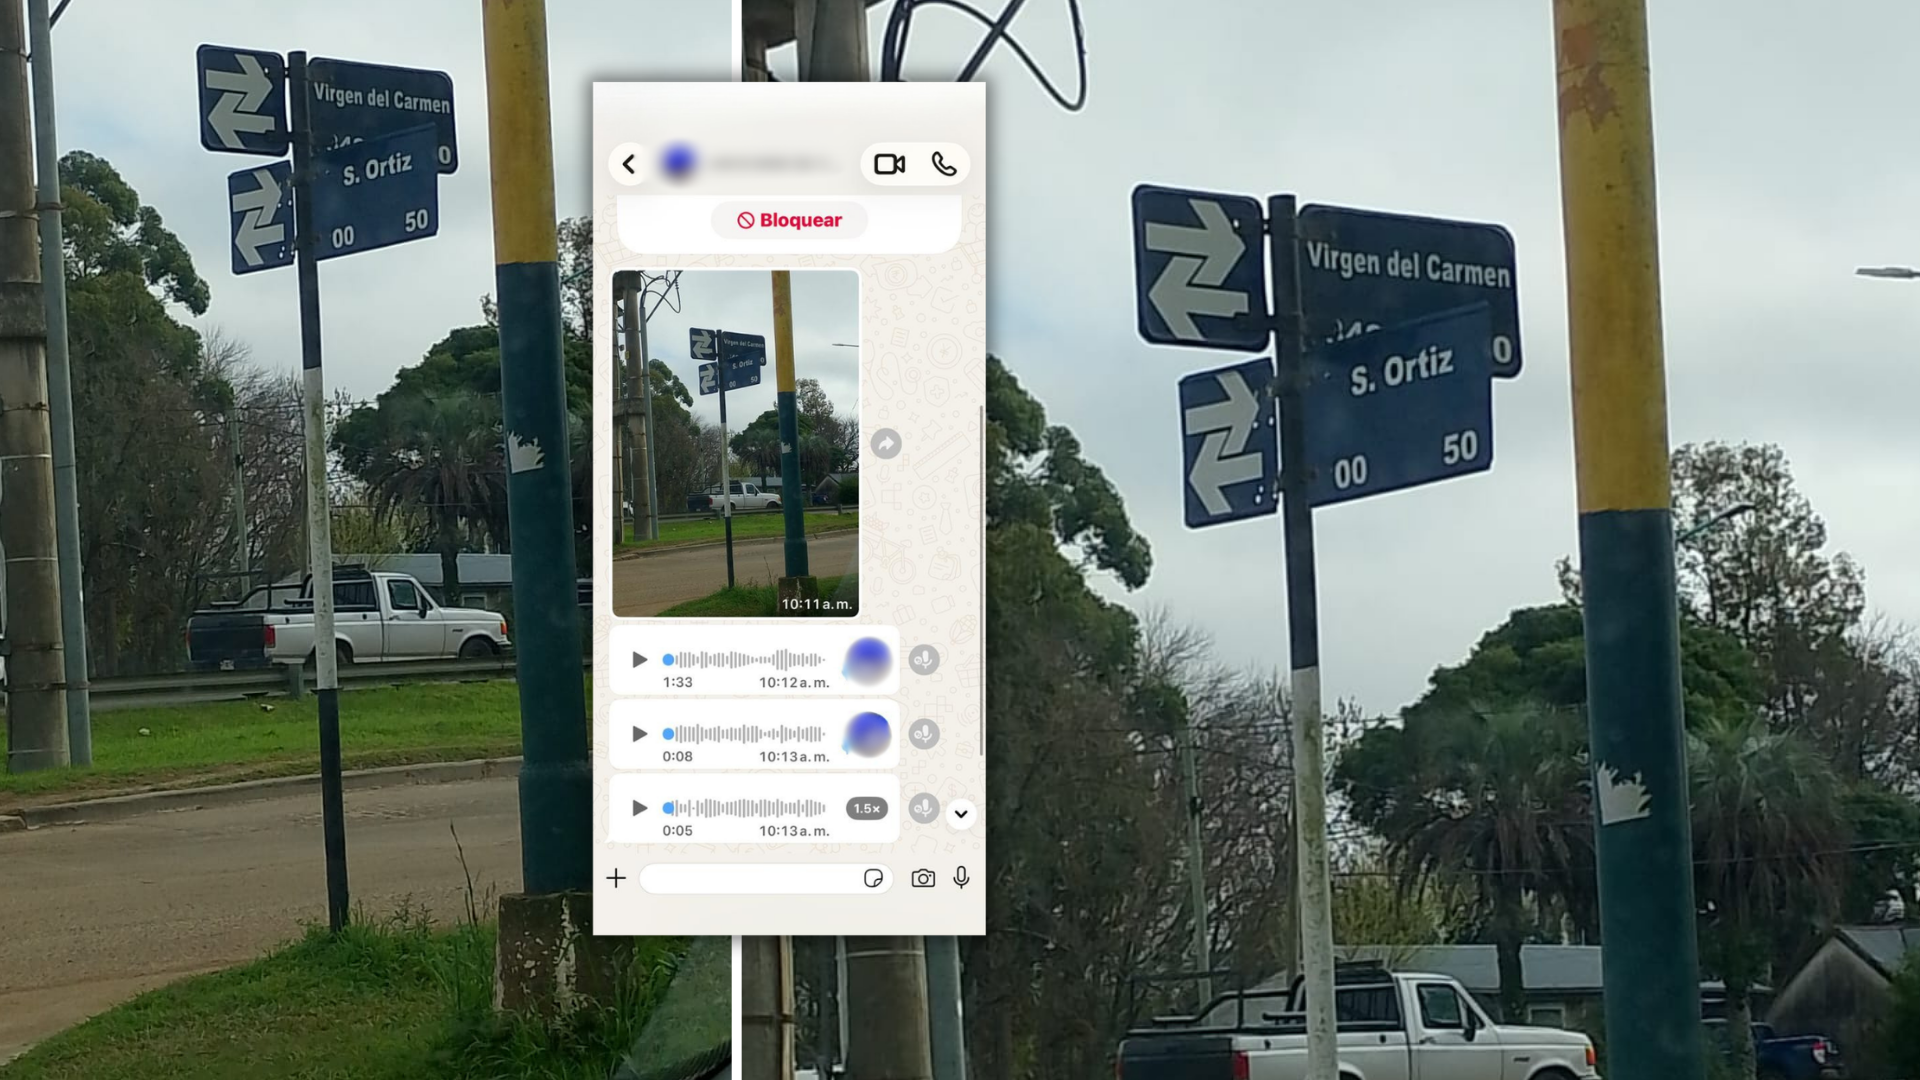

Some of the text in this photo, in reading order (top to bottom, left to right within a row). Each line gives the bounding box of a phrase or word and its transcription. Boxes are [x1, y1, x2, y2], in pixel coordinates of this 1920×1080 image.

[314, 82, 451, 114] Virgen del Carmen
[343, 153, 413, 186] S. Ortiz
[405, 208, 429, 232] 50
[760, 212, 843, 230] Bloquear
[332, 225, 355, 248] 00
[1307, 241, 1512, 288] Virgen del Carmen
[724, 339, 739, 347] Virgen
[739, 360, 753, 368] Ortiz
[1351, 346, 1454, 396] S. Ortiz
[1443, 430, 1478, 465] 50
[1335, 455, 1368, 489] 00
[663, 676, 693, 688] 1:33
[662, 750, 693, 762] 0:08
[662, 824, 693, 837] 0:05
